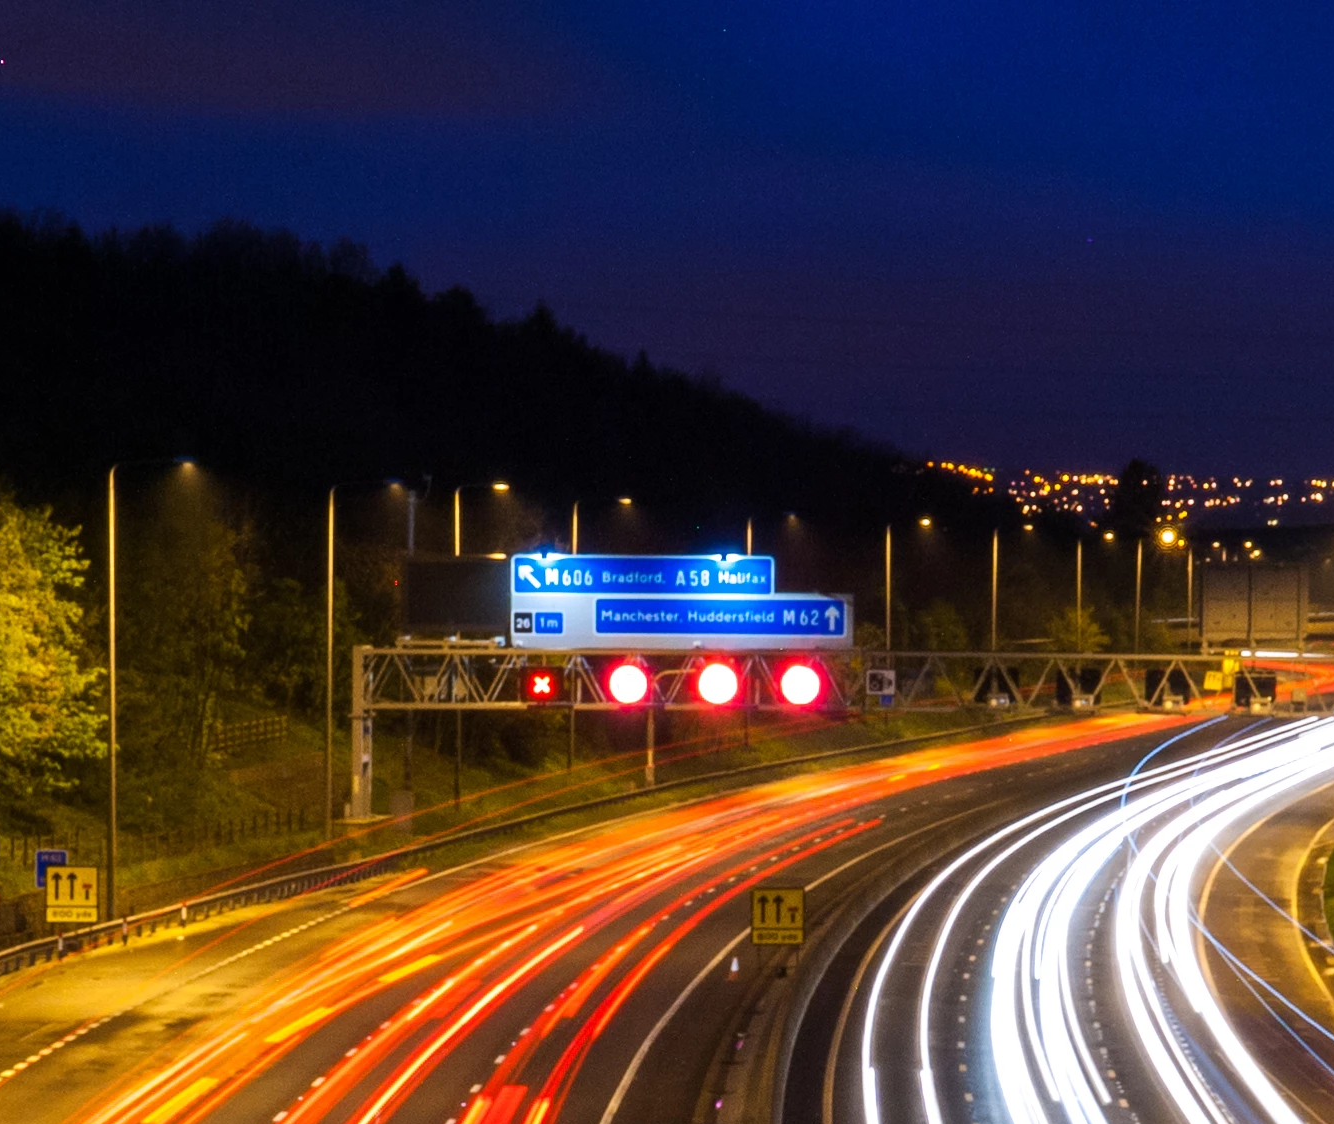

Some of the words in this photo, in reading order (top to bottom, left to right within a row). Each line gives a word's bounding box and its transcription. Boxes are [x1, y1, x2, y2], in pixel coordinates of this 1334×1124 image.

[545, 568, 593, 586] M606
[675, 570, 710, 586] A58
[718, 570, 766, 584] Halifax
[688, 610, 774, 623] Huddersfield
[515, 618, 531, 629] 26
